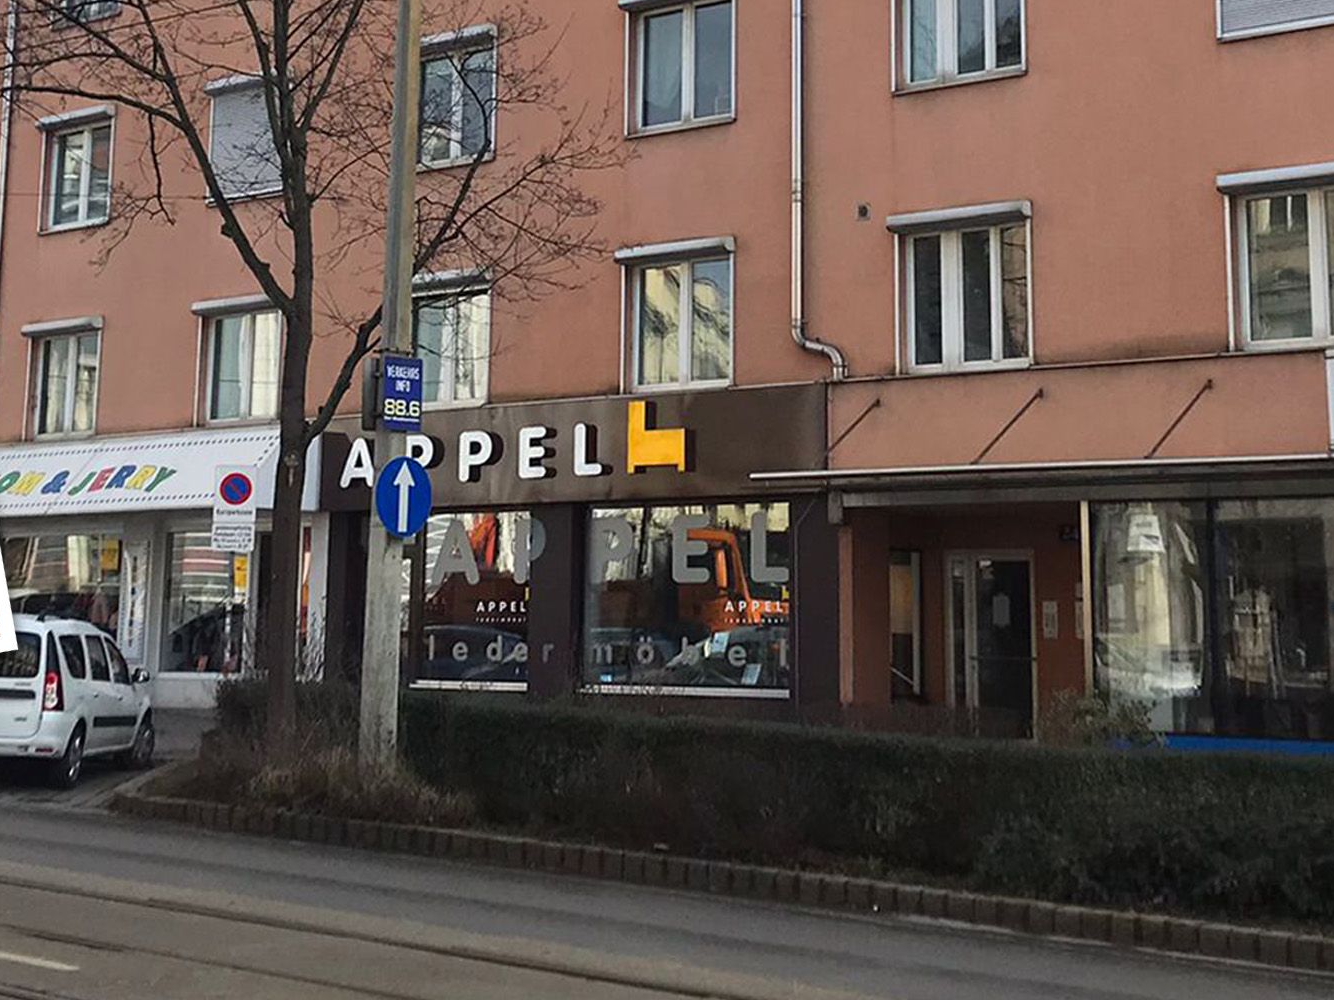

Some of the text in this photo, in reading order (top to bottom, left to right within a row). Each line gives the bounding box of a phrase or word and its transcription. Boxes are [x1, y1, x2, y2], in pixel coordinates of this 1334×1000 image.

[384, 398, 420, 417] 88.6
[340, 422, 603, 488] APPEL
[40, 470, 70, 495] &
[67, 464, 177, 496] JERRY
[476, 601, 527, 613] APPEL
[724, 600, 784, 613] APPEL
